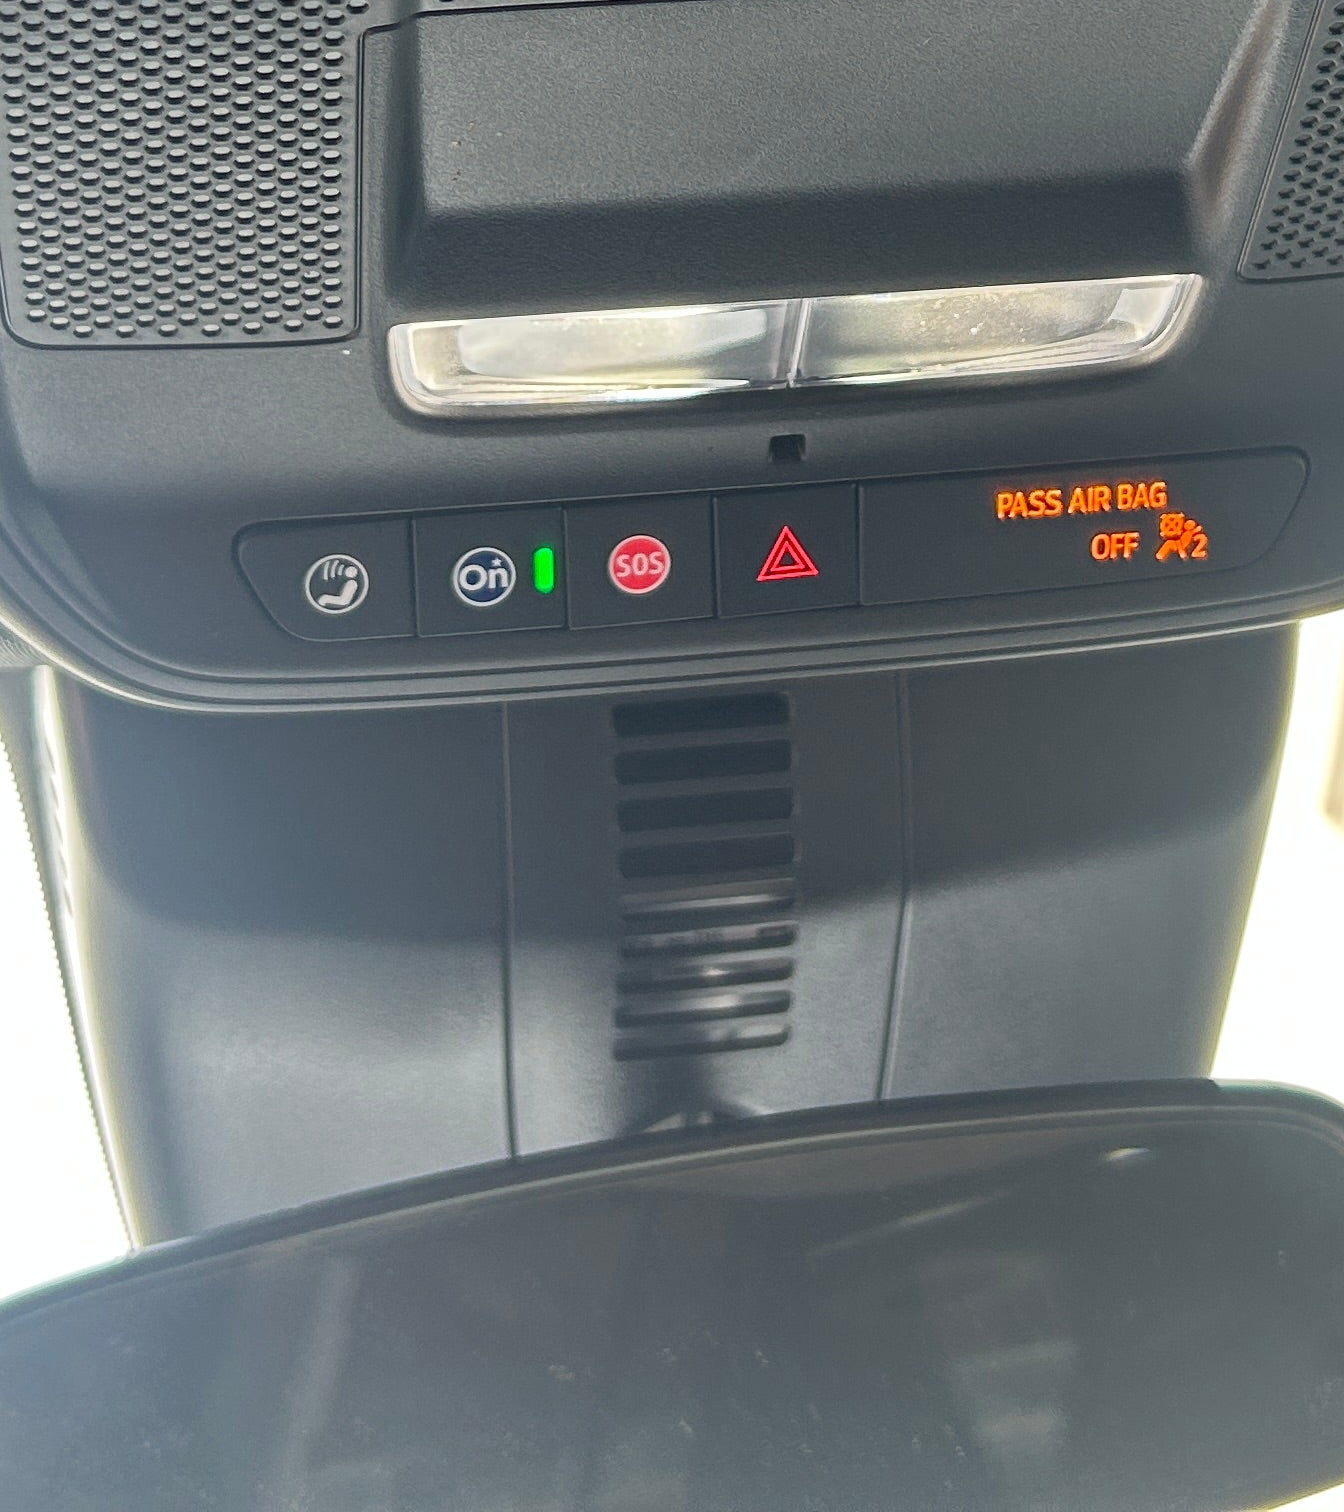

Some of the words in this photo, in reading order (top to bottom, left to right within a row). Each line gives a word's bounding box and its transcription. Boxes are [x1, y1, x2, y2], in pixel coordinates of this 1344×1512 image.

[996, 490, 1063, 519] PASS
[1067, 487, 1112, 514] AIR
[1116, 481, 1167, 510] BAG
[1090, 532, 1140, 560] OFF
[1191, 533, 1208, 558] 2
[458, 561, 509, 591] On
[615, 551, 666, 577] SOS
